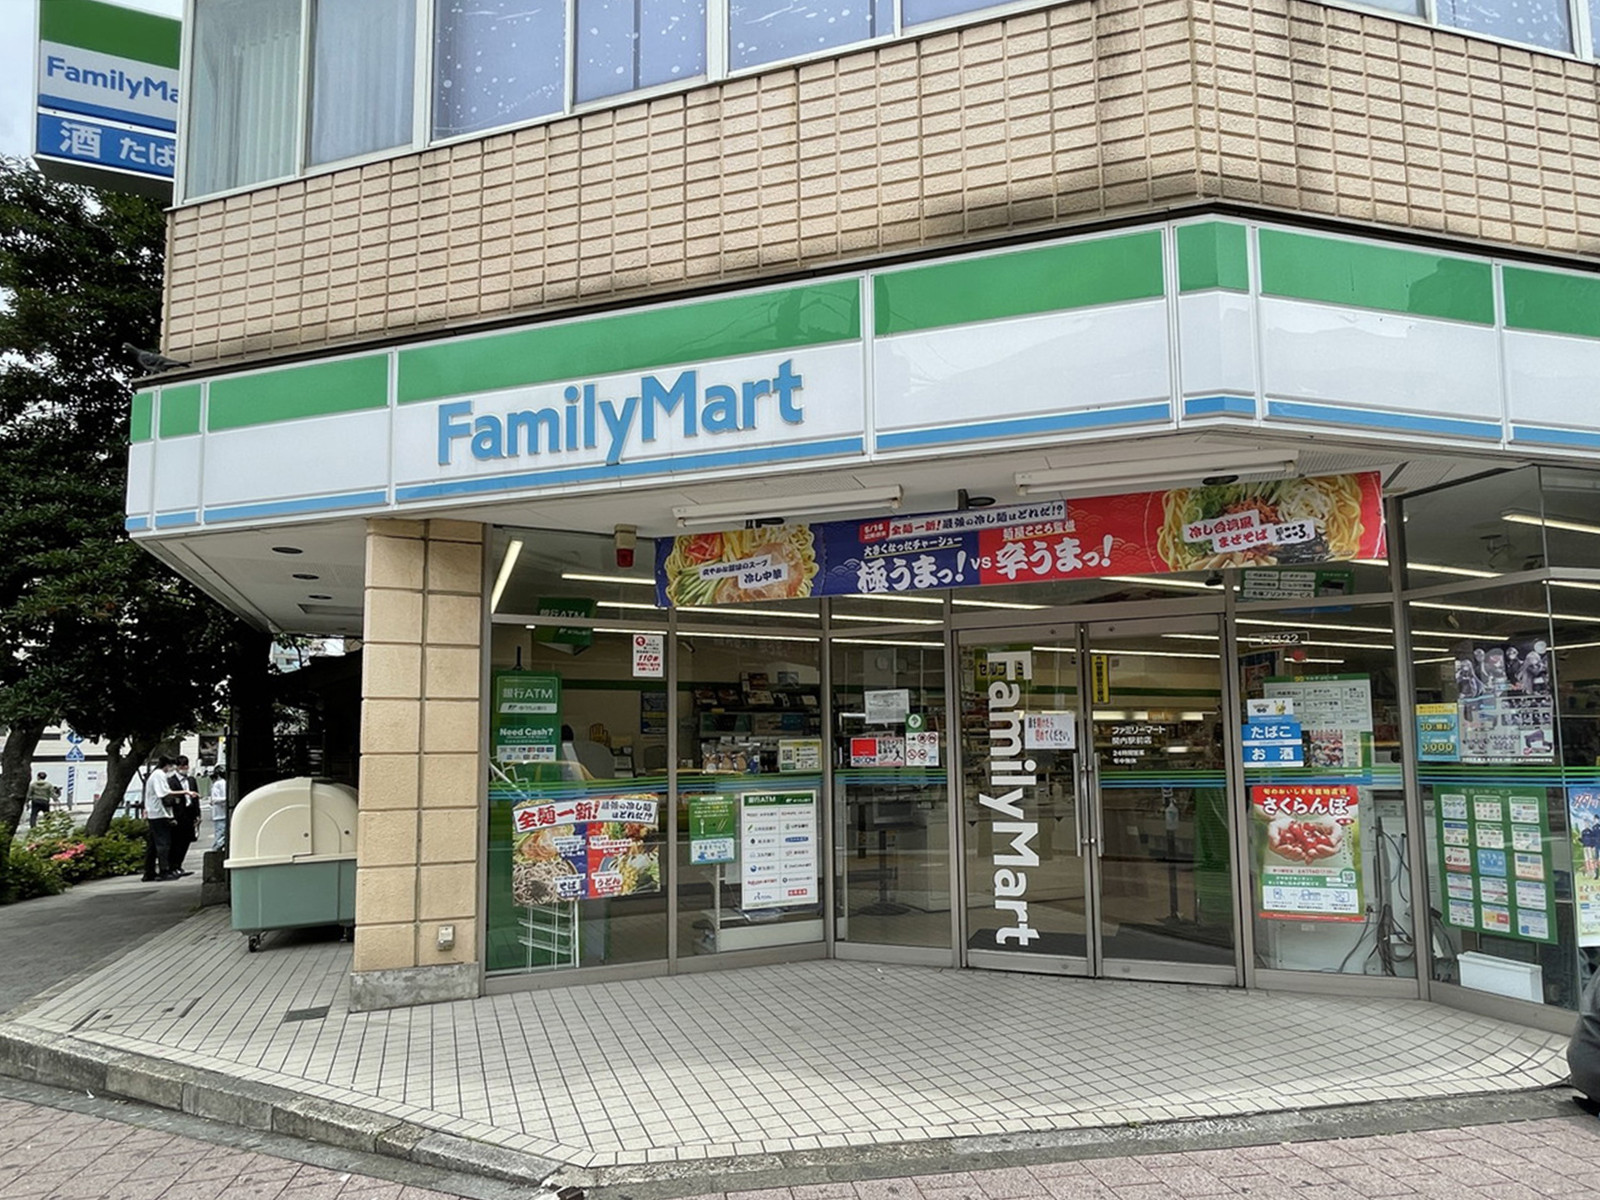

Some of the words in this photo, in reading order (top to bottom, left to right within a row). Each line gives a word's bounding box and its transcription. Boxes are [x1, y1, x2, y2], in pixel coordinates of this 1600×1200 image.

[59, 121, 102, 159] 酒
[438, 359, 804, 466] FamilyMart
[995, 534, 1113, 580] 辛うまっ!
[857, 550, 967, 593] 極うまっ!
[502, 687, 554, 699] 銀行ATM
[499, 727, 524, 736] Need
[524, 727, 554, 736] Cash?
[1111, 725, 1166, 735] ファミリーマート
[1250, 726, 1292, 739] たばこ
[978, 649, 1041, 948] FamilyMart
[1262, 795, 1351, 816] さくらんぼ
[517, 800, 601, 831] 全麺一新!
[596, 878, 622, 887] うどん
